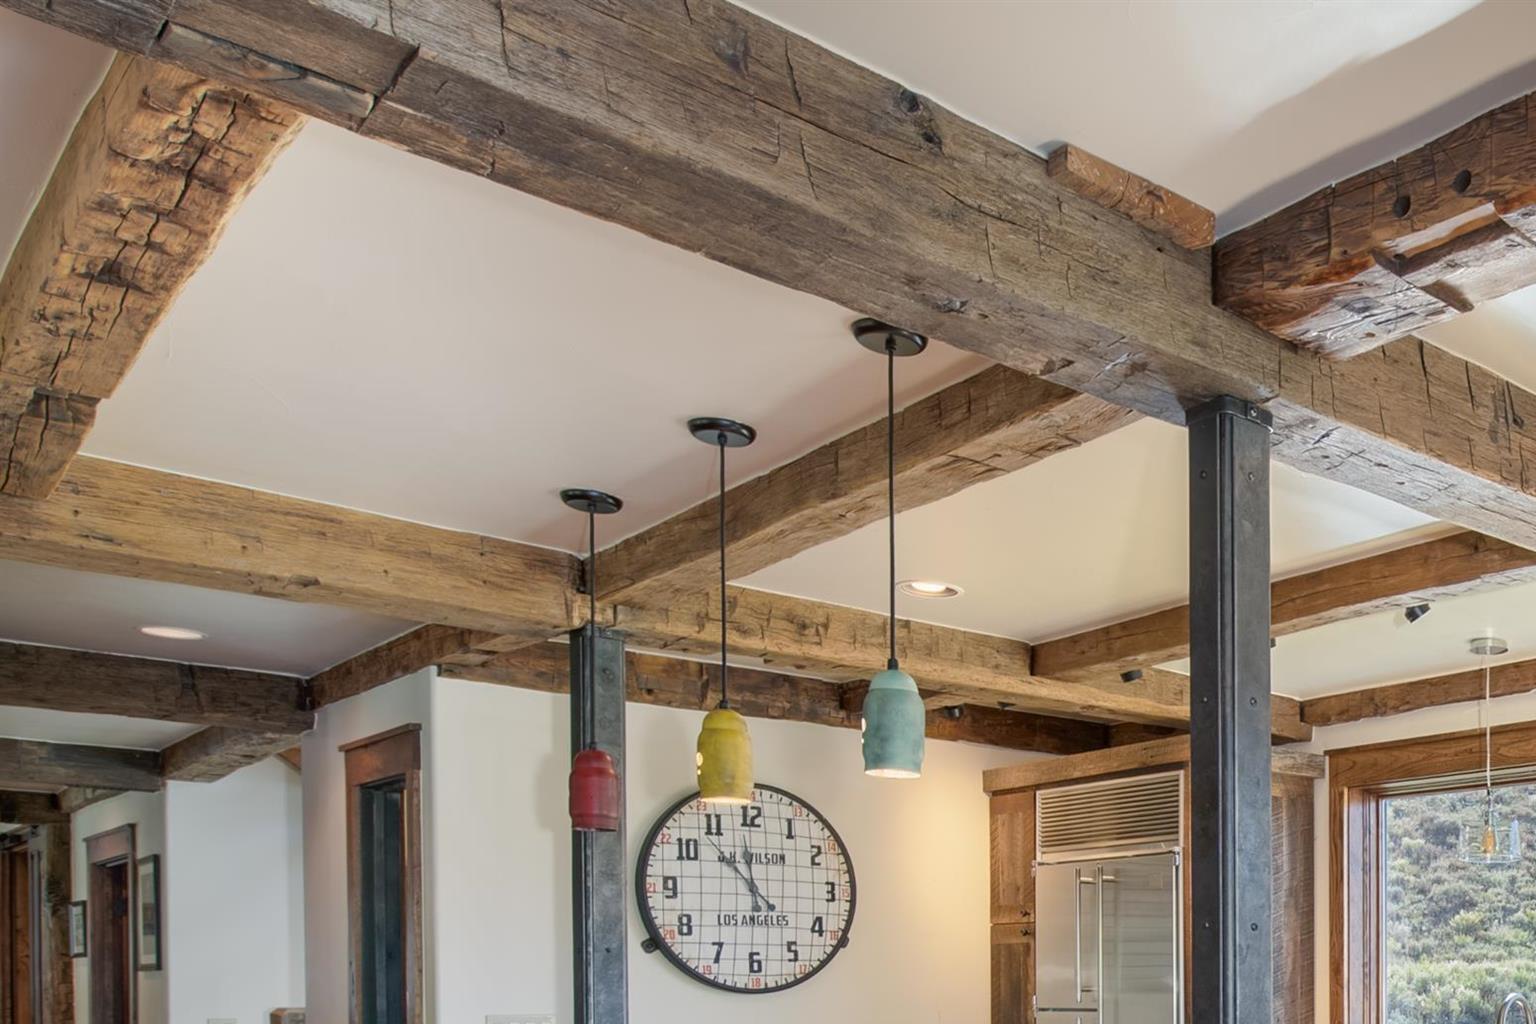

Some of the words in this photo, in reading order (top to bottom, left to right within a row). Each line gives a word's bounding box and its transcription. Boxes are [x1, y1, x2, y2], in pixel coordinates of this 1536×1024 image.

[696, 800, 707, 811] 23
[795, 806, 802, 817] 13
[704, 814, 724, 836] 11
[740, 806, 761, 828] 12
[785, 818, 794, 840] 1
[661, 833, 671, 843] 22
[676, 838, 698, 861] 10
[827, 841, 836, 852] 14
[810, 845, 822, 866] 2
[647, 883, 656, 893] 21
[663, 876, 678, 899] 9
[825, 881, 835, 903] 3
[841, 887, 850, 898] 15
[677, 914, 693, 936] 8
[717, 914, 738, 926] LOS
[741, 914, 789, 926] ANGELES
[810, 916, 824, 937] 4
[663, 929, 675, 940] 20
[830, 931, 838, 941] 16
[712, 942, 723, 964] 7
[787, 941, 798, 962] 5
[702, 965, 712, 975] 19
[749, 952, 762, 973] 6
[799, 965, 807, 975] 17
[751, 978, 761, 988] 18
